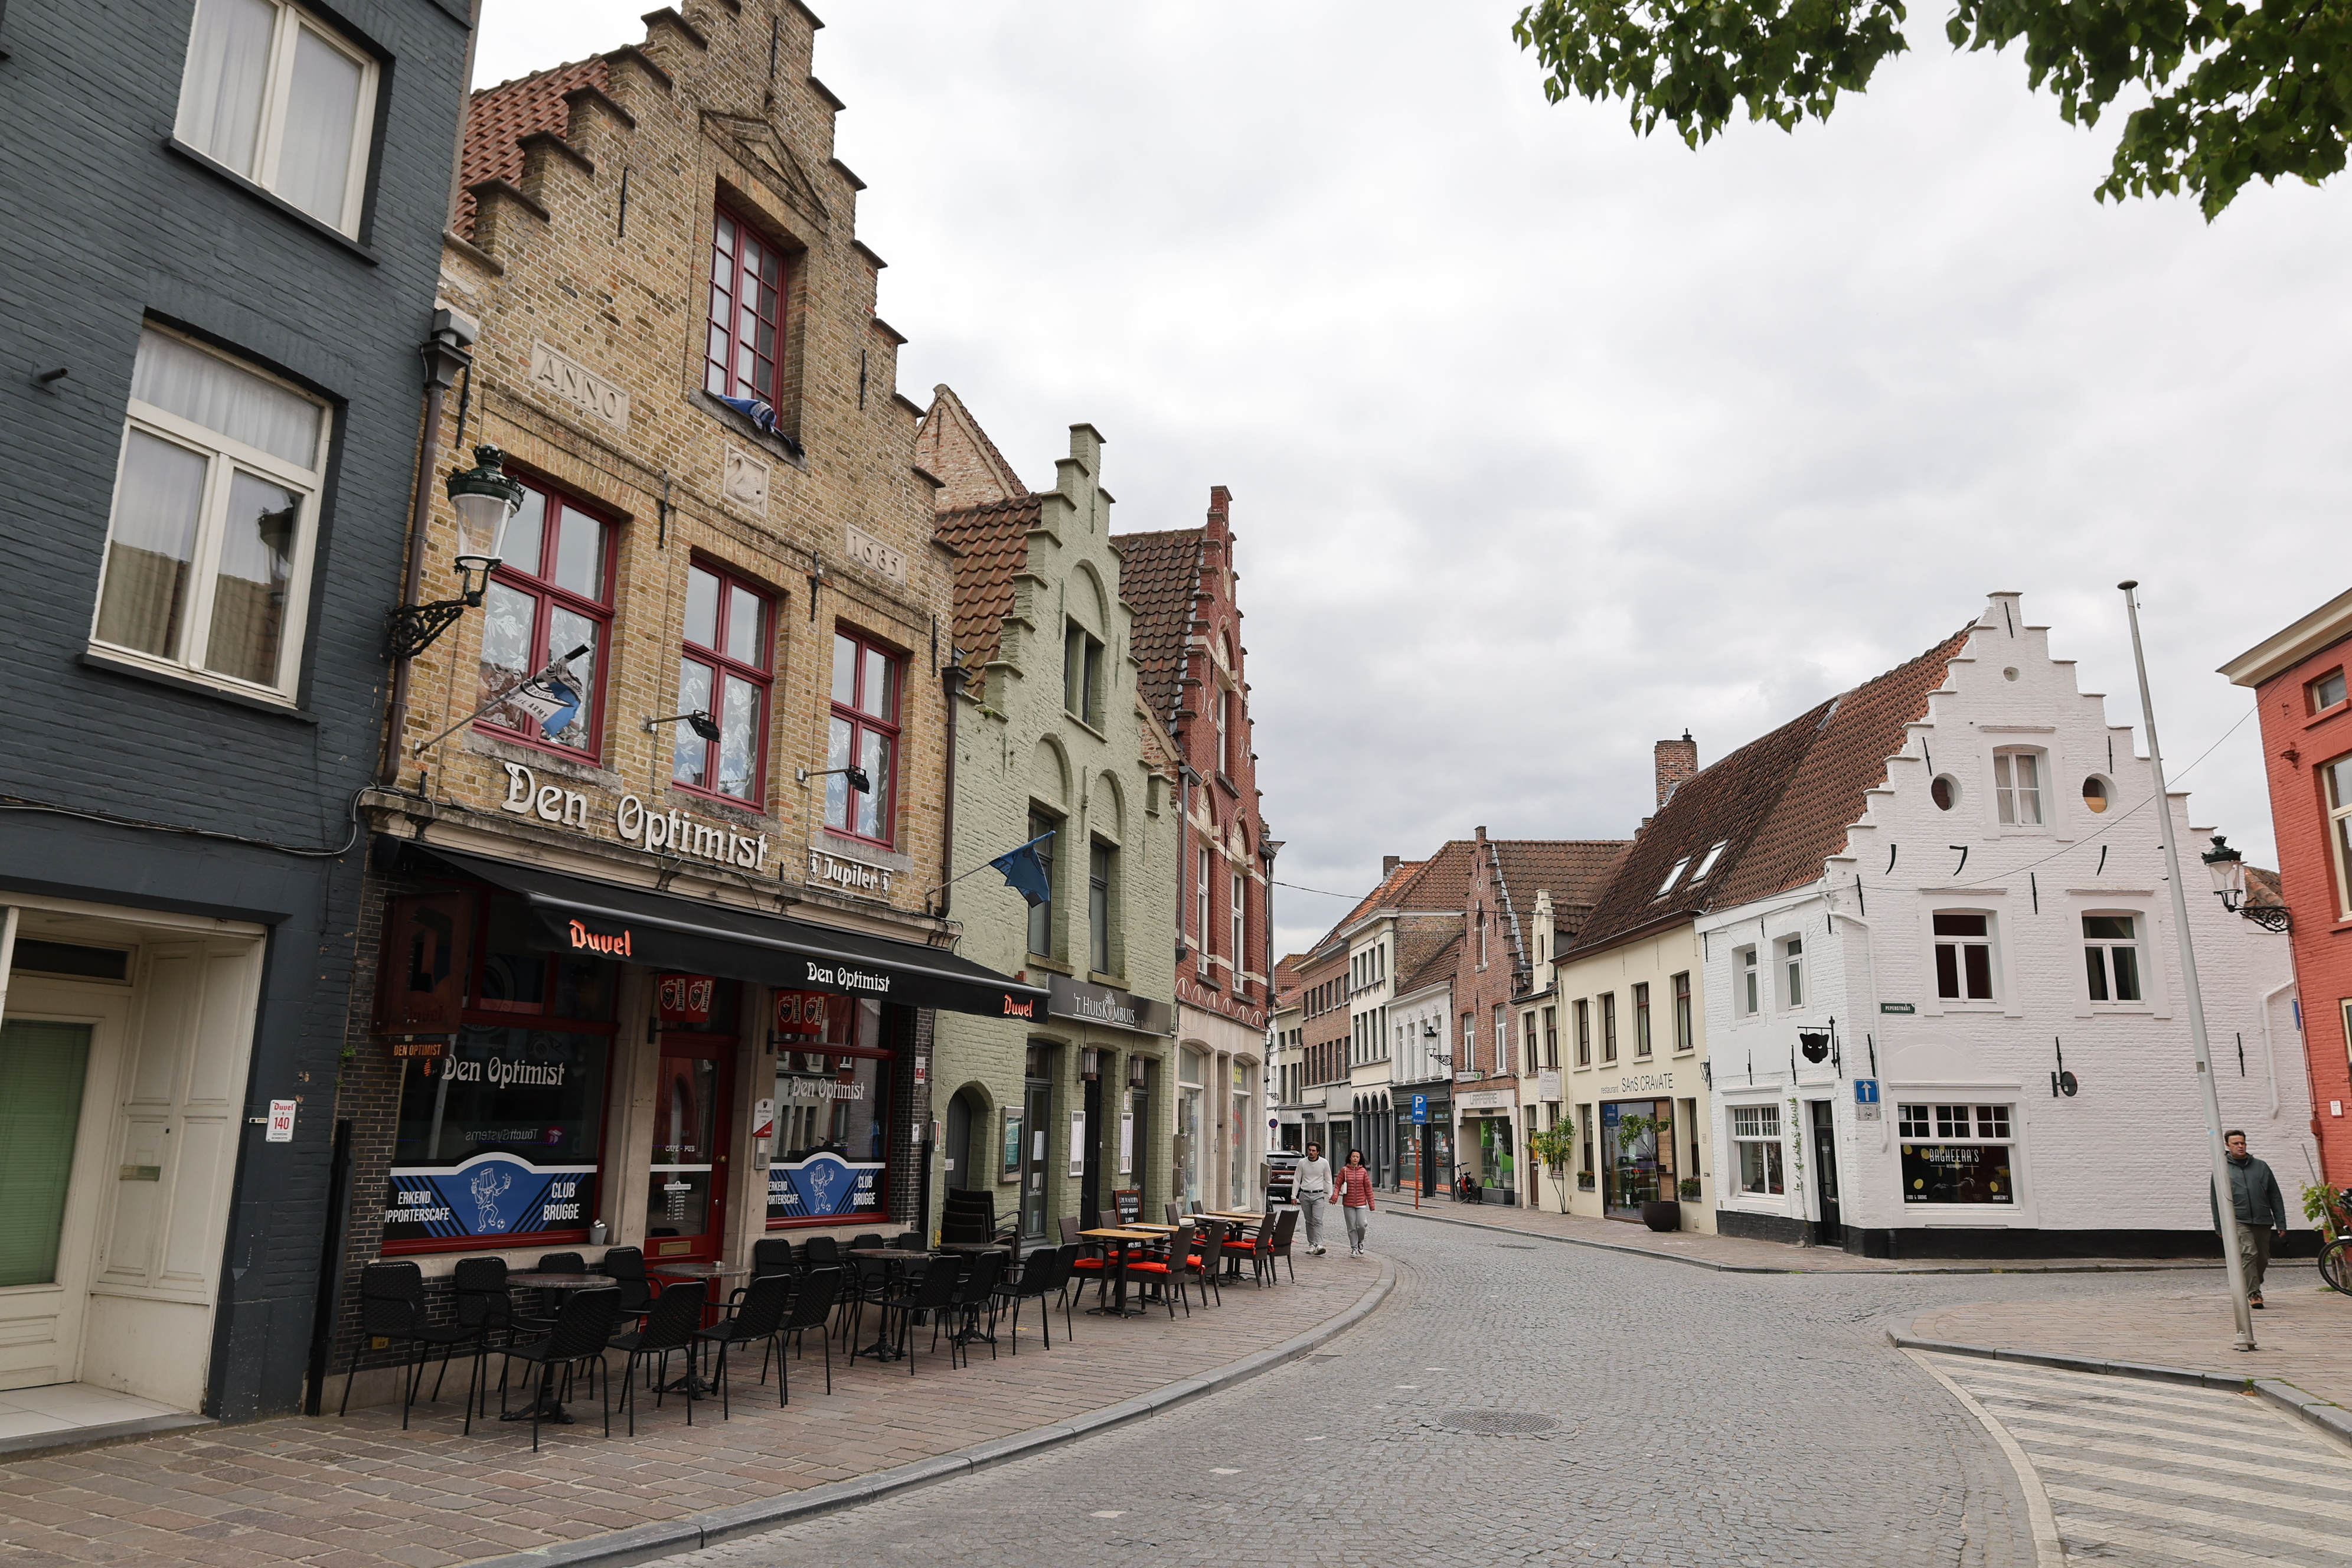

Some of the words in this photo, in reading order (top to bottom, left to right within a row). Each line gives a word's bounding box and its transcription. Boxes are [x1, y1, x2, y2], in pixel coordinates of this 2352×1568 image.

[538, 354, 616, 419] ANNO
[851, 534, 899, 577] 1685
[528, 703, 549, 719] ARMY
[501, 762, 589, 829] Den
[617, 795, 769, 871] Optimist
[822, 857, 878, 889] Jupiler
[568, 919, 633, 958] Duvel
[806, 961, 834, 984] Den
[837, 967, 890, 992] Optimist
[677, 981, 685, 1010] Jupiler
[701, 982, 711, 1011] Jupiler
[1004, 994, 1033, 1018] Duvel
[394, 1044, 408, 1056] DEN
[409, 1044, 442, 1057] OPTIMIST
[441, 1054, 480, 1082] Den
[487, 1056, 565, 1089] Optimist
[792, 1076, 815, 1098] Den
[818, 1076, 865, 1103] Optimist
[1622, 1076, 1639, 1093] SAnS
[1641, 1073, 1673, 1090] CRAvATE
[274, 1102, 294, 1110] Duvel
[1415, 1096, 1424, 1108] P
[274, 1117, 290, 1130] 140
[1929, 1148, 1979, 1162] BAGHEERA'S
[551, 1182, 576, 1199] CLUB
[768, 1181, 788, 1192] ERKEND
[858, 1175, 873, 1188] CLUB
[397, 1191, 431, 1205] ERKEND
[853, 1192, 876, 1206] BRUGGE
[543, 1203, 580, 1221] BRUGGE
